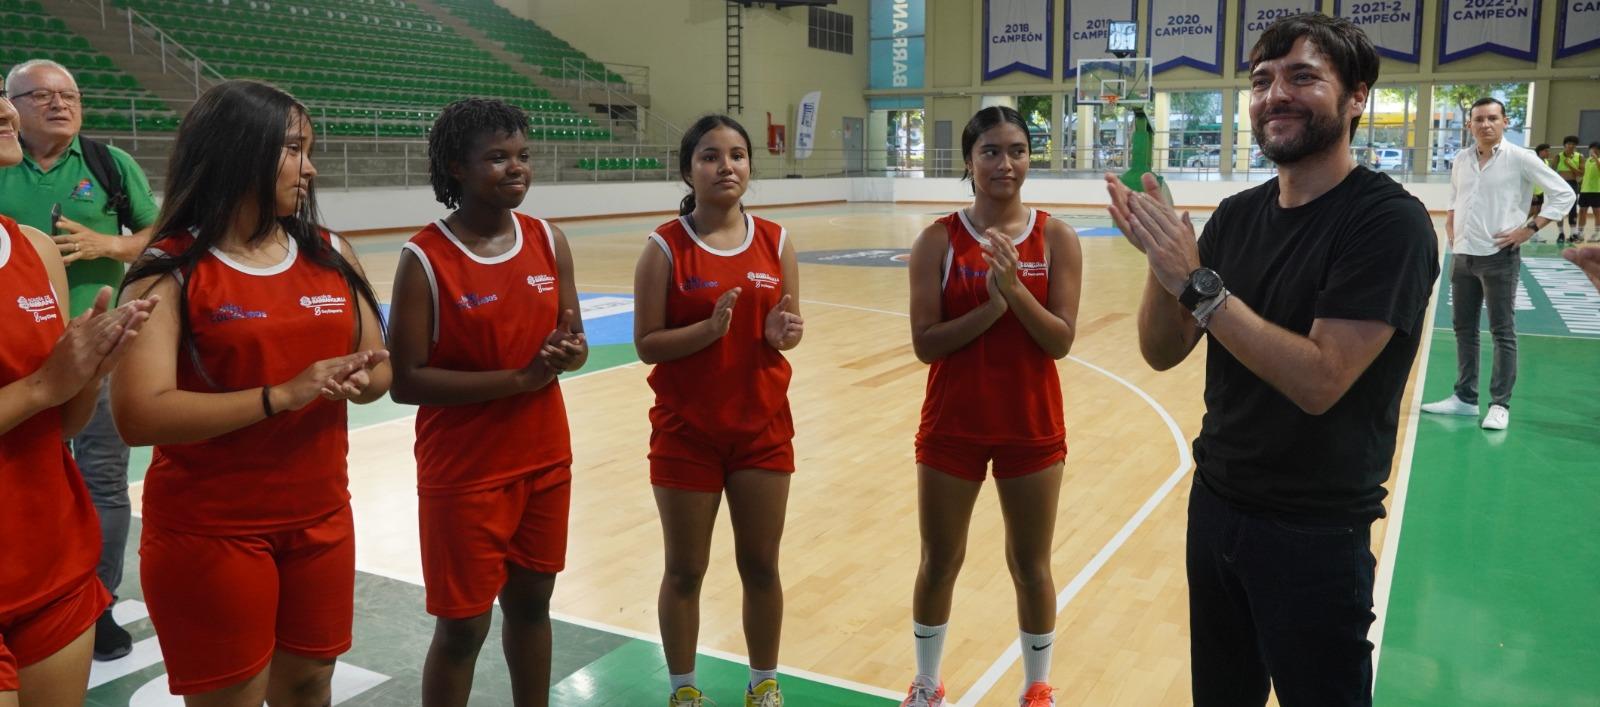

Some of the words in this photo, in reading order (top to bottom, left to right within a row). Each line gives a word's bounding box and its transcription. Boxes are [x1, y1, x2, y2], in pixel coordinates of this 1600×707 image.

[1352, 1, 1402, 14] 2021-2
[1453, 7, 1528, 20] CAMPEÓN
[1168, 14, 1200, 25] 2020
[1345, 12, 1411, 25] AMPEÓN
[1005, 23, 1029, 33] 2018
[1155, 24, 1213, 37] CAMPEÓN
[992, 33, 1043, 44] CAMPEÓN
[1073, 30, 1107, 41] CAMPE
